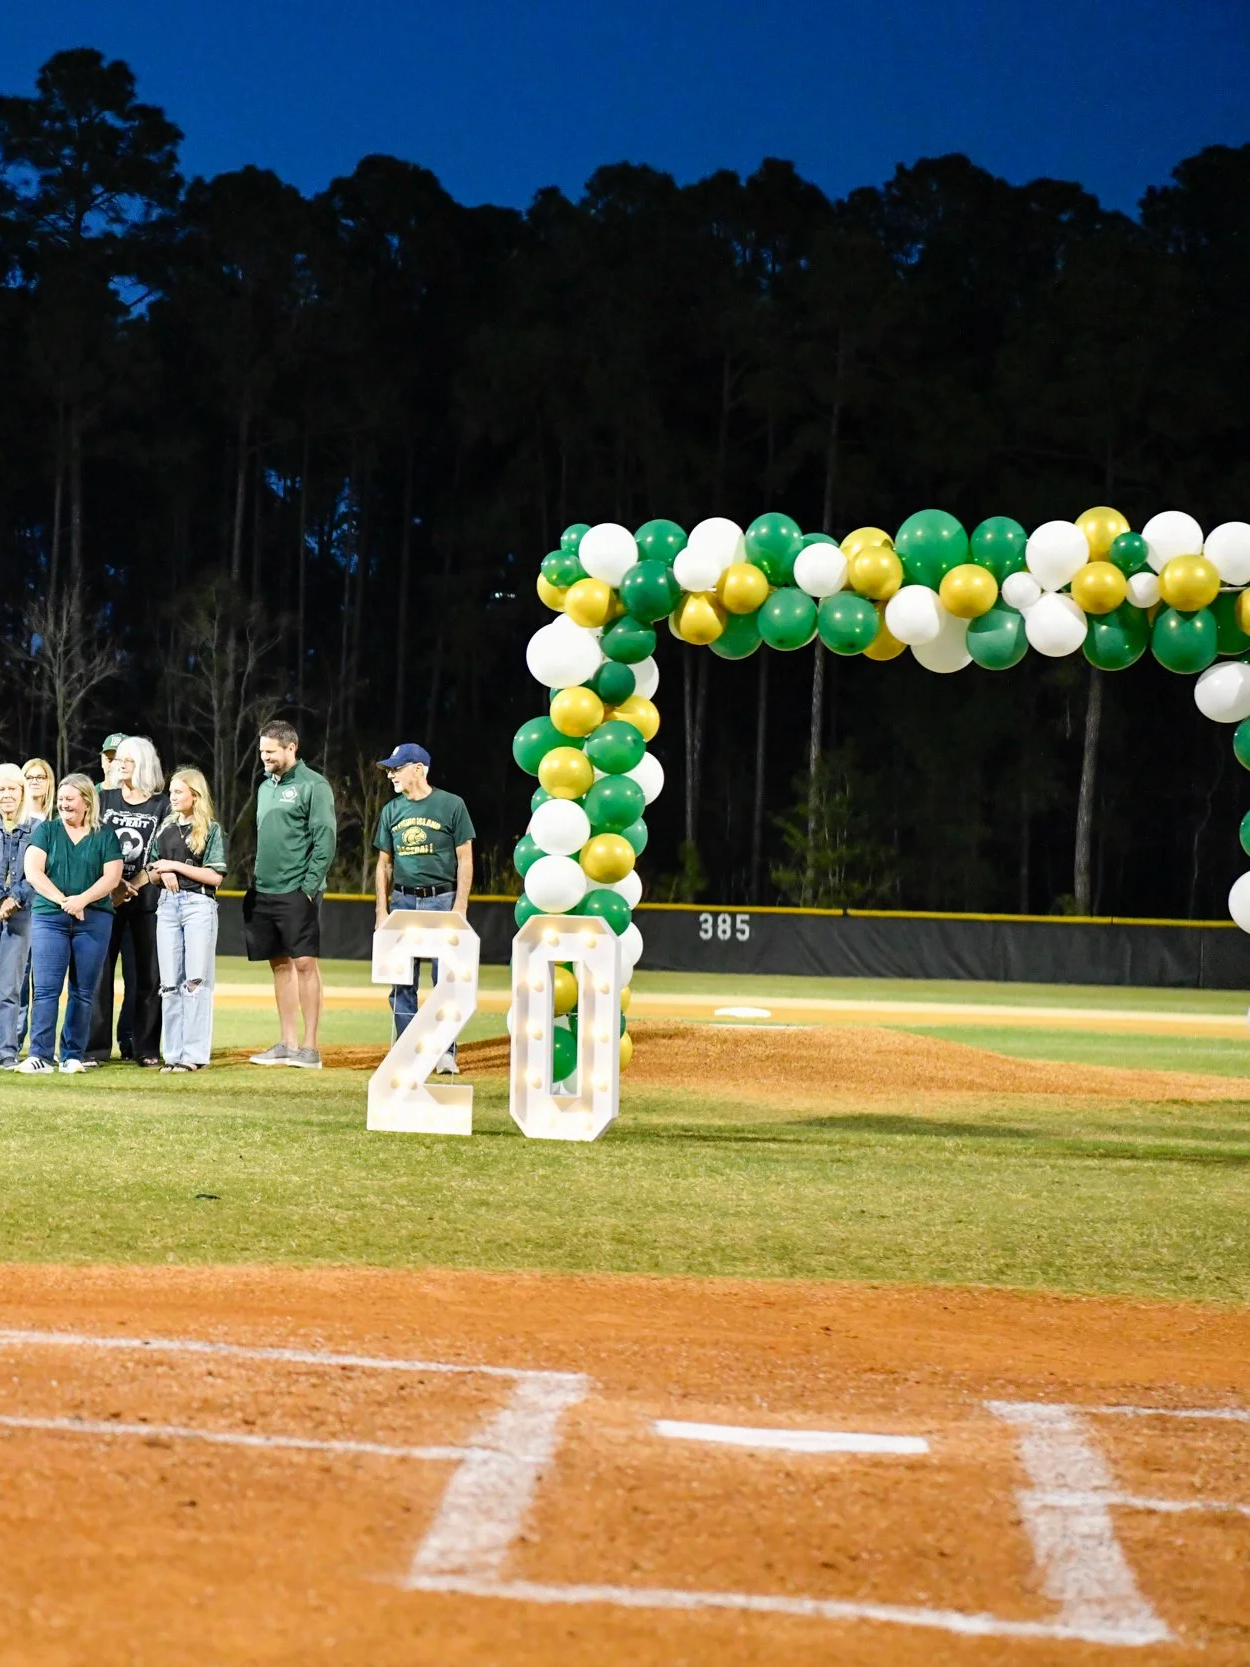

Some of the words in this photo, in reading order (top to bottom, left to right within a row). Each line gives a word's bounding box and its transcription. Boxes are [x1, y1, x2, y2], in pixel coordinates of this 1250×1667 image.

[112, 816, 149, 828] STRAIT
[416, 817, 441, 830] ISLAND
[699, 912, 750, 941] 385
[367, 909, 621, 1142] 20
